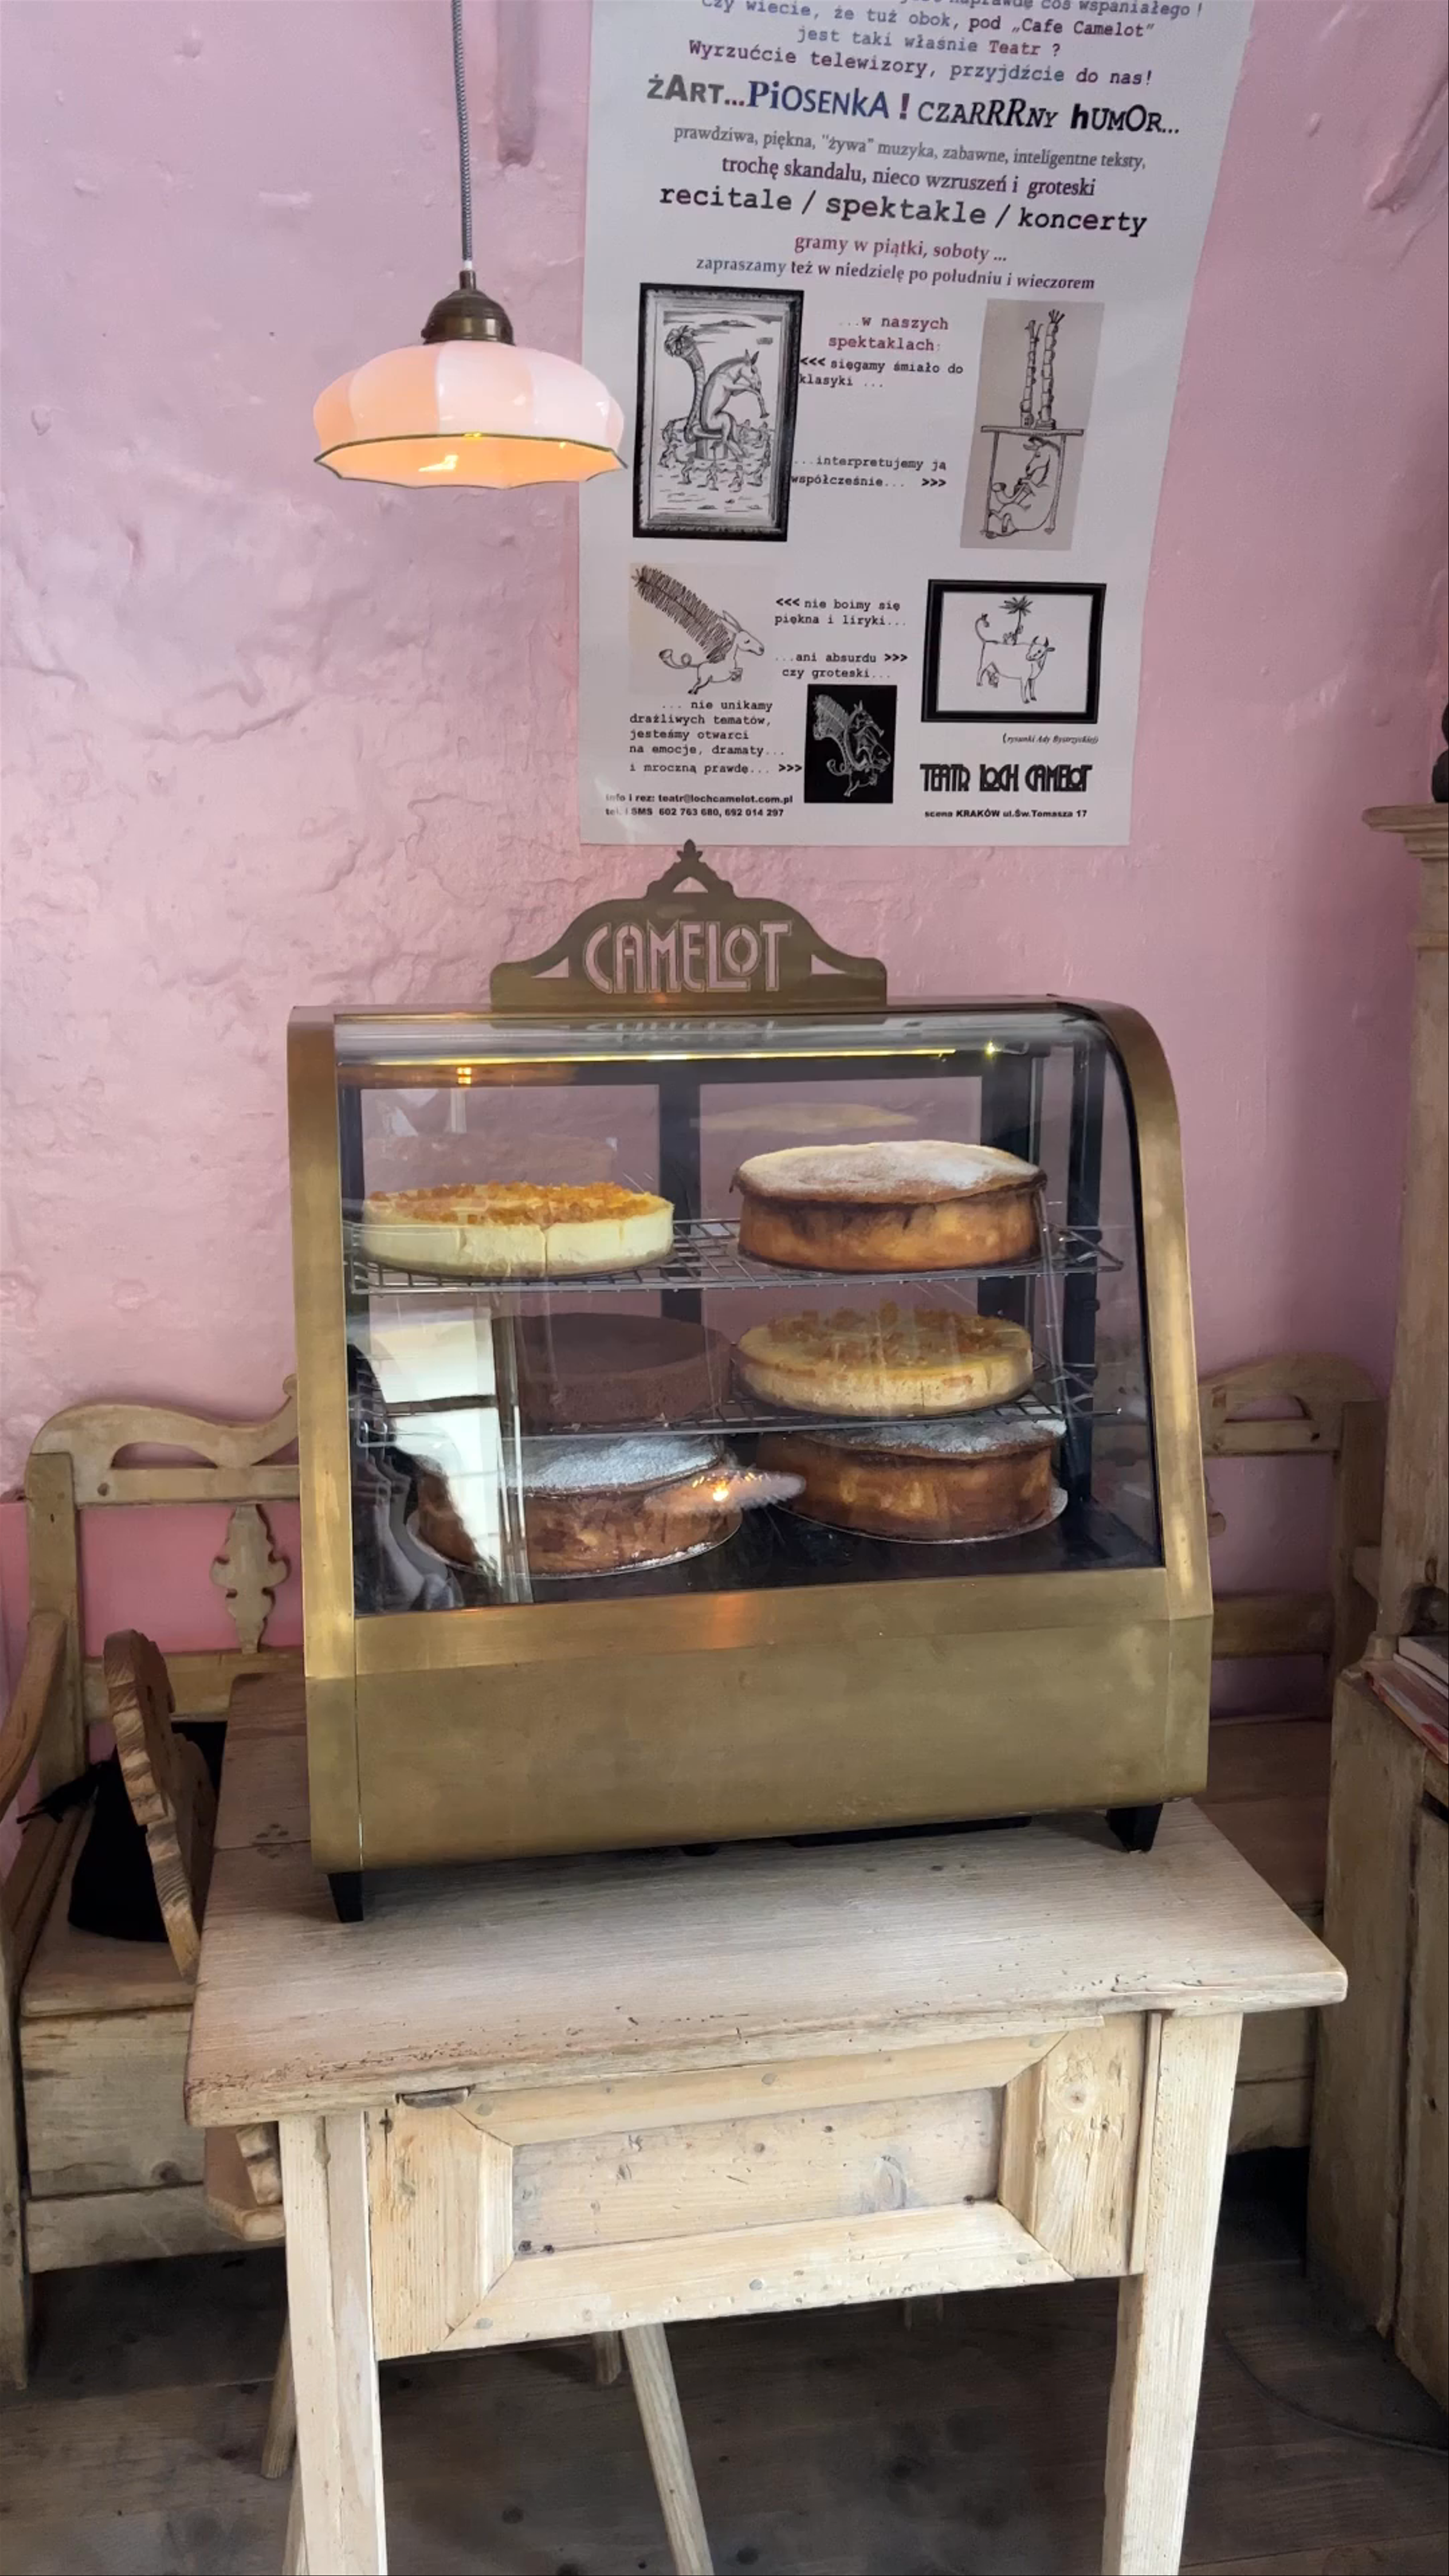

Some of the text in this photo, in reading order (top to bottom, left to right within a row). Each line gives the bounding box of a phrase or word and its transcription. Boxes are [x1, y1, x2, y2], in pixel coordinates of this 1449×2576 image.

[746, 0, 818, 20] wiecie,
[834, 5, 854, 20] że
[866, 8, 897, 23] tuż
[909, 11, 959, 31] obok,
[968, 15, 1001, 33] pod
[1079, 0, 1190, 20] wspaniałego
[797, 26, 1060, 57] jest taki właśnie Teatr ?
[689, 40, 1152, 86] Wyrzućcie telewizory, przyjdźcie do nas!
[674, 125, 758, 146] prawdziwa,
[763, 130, 815, 150] piękna,
[877, 141, 938, 161] muzyka,
[942, 145, 1009, 165] zabawne,
[1013, 148, 1097, 169] inteligentne
[1101, 151, 1146, 172] teksty,
[722, 156, 1096, 200] trochę skandalu, nieco wzruszeń i groteski
[659, 185, 792, 211] recitale
[826, 195, 986, 225] spektakle
[1017, 206, 1148, 238] koncerty
[794, 237, 849, 256] gramy
[854, 240, 868, 252] w
[873, 238, 928, 258] piątki,
[933, 242, 990, 265] soboty
[696, 259, 1095, 289] zapraszamy też w niedzielę po południu i wieczorem
[881, 317, 948, 332] naszych
[831, 358, 885, 374] sięgamy
[893, 361, 940, 373] śmiało
[948, 363, 963, 374] do
[799, 373, 853, 389] klasyki
[804, 598, 826, 609] nie
[833, 599, 871, 612] boimy
[878, 600, 900, 612] się
[774, 613, 820, 626] piękna
[827, 614, 834, 624] i
[826, 652, 876, 663] absurdu
[782, 669, 805, 680] czy
[691, 700, 713, 709] nie
[721, 700, 773, 713] unikamy
[630, 713, 770, 727] drażliwych tematów,
[630, 729, 749, 742] jesteśmy otwarci
[651, 744, 702, 757] emocje,
[643, 764, 697, 774] mroczną
[658, 794, 793, 805] teatr@lochcamelot.com.pl
[631, 807, 653, 815] SMS
[659, 807, 677, 816] 602
[680, 807, 698, 816] 763
[701, 808, 722, 818] 680,
[724, 808, 743, 817] 692
[745, 808, 763, 817] 014
[766, 808, 784, 817] 297
[956, 808, 1001, 818] KRAKÓW
[1076, 809, 1088, 818] 17
[583, 918, 794, 994] CAMELOT
